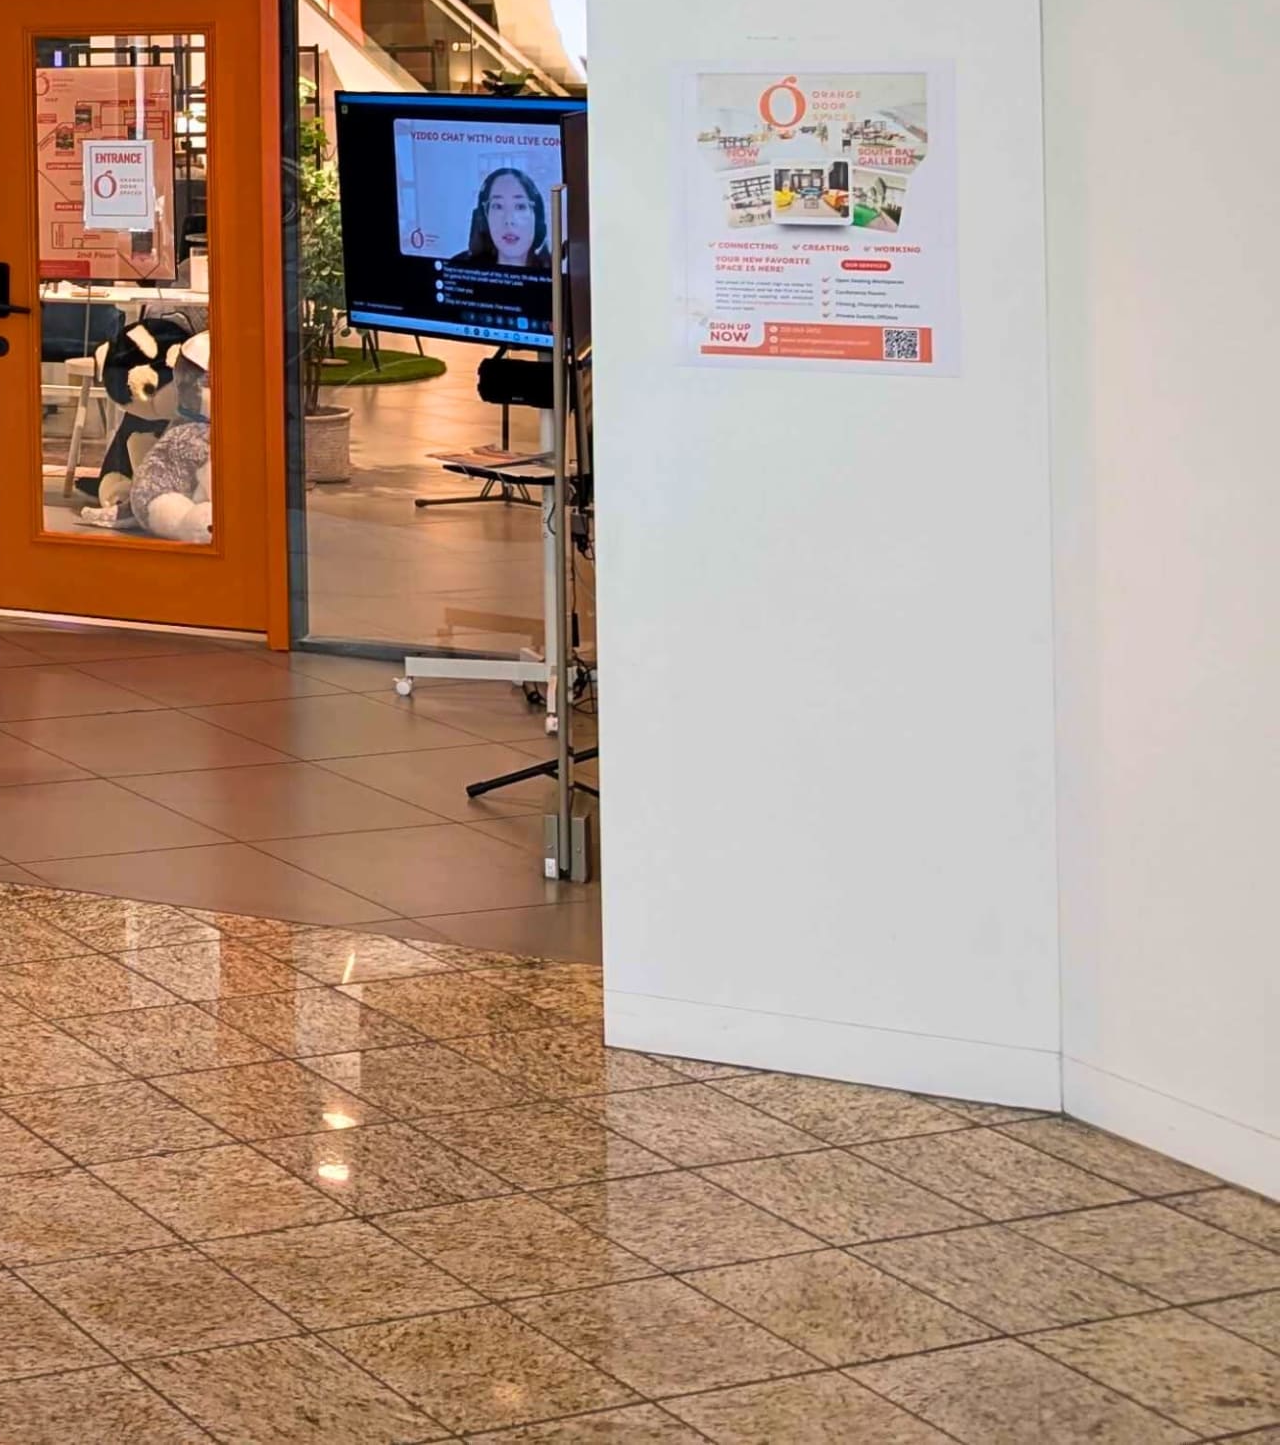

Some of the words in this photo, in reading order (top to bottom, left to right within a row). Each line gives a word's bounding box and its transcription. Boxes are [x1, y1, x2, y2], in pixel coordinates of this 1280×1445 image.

[410, 131, 439, 141] VIDEO
[440, 132, 464, 142] CHAT
[467, 134, 491, 144] WITH
[495, 135, 516, 145] OUR
[518, 136, 540, 146] LIVE
[858, 147, 892, 157] SOUTH
[95, 152, 143, 164] ENTRANCE
[858, 156, 915, 166] GALLERIA
[718, 242, 779, 251] CONNECTING
[802, 244, 850, 252] CREATING
[873, 245, 921, 254] WORKING
[765, 257, 811, 265] FAVORITE
[709, 322, 735, 330] SIGN
[737, 323, 752, 332] UP
[710, 331, 749, 343] NOW
